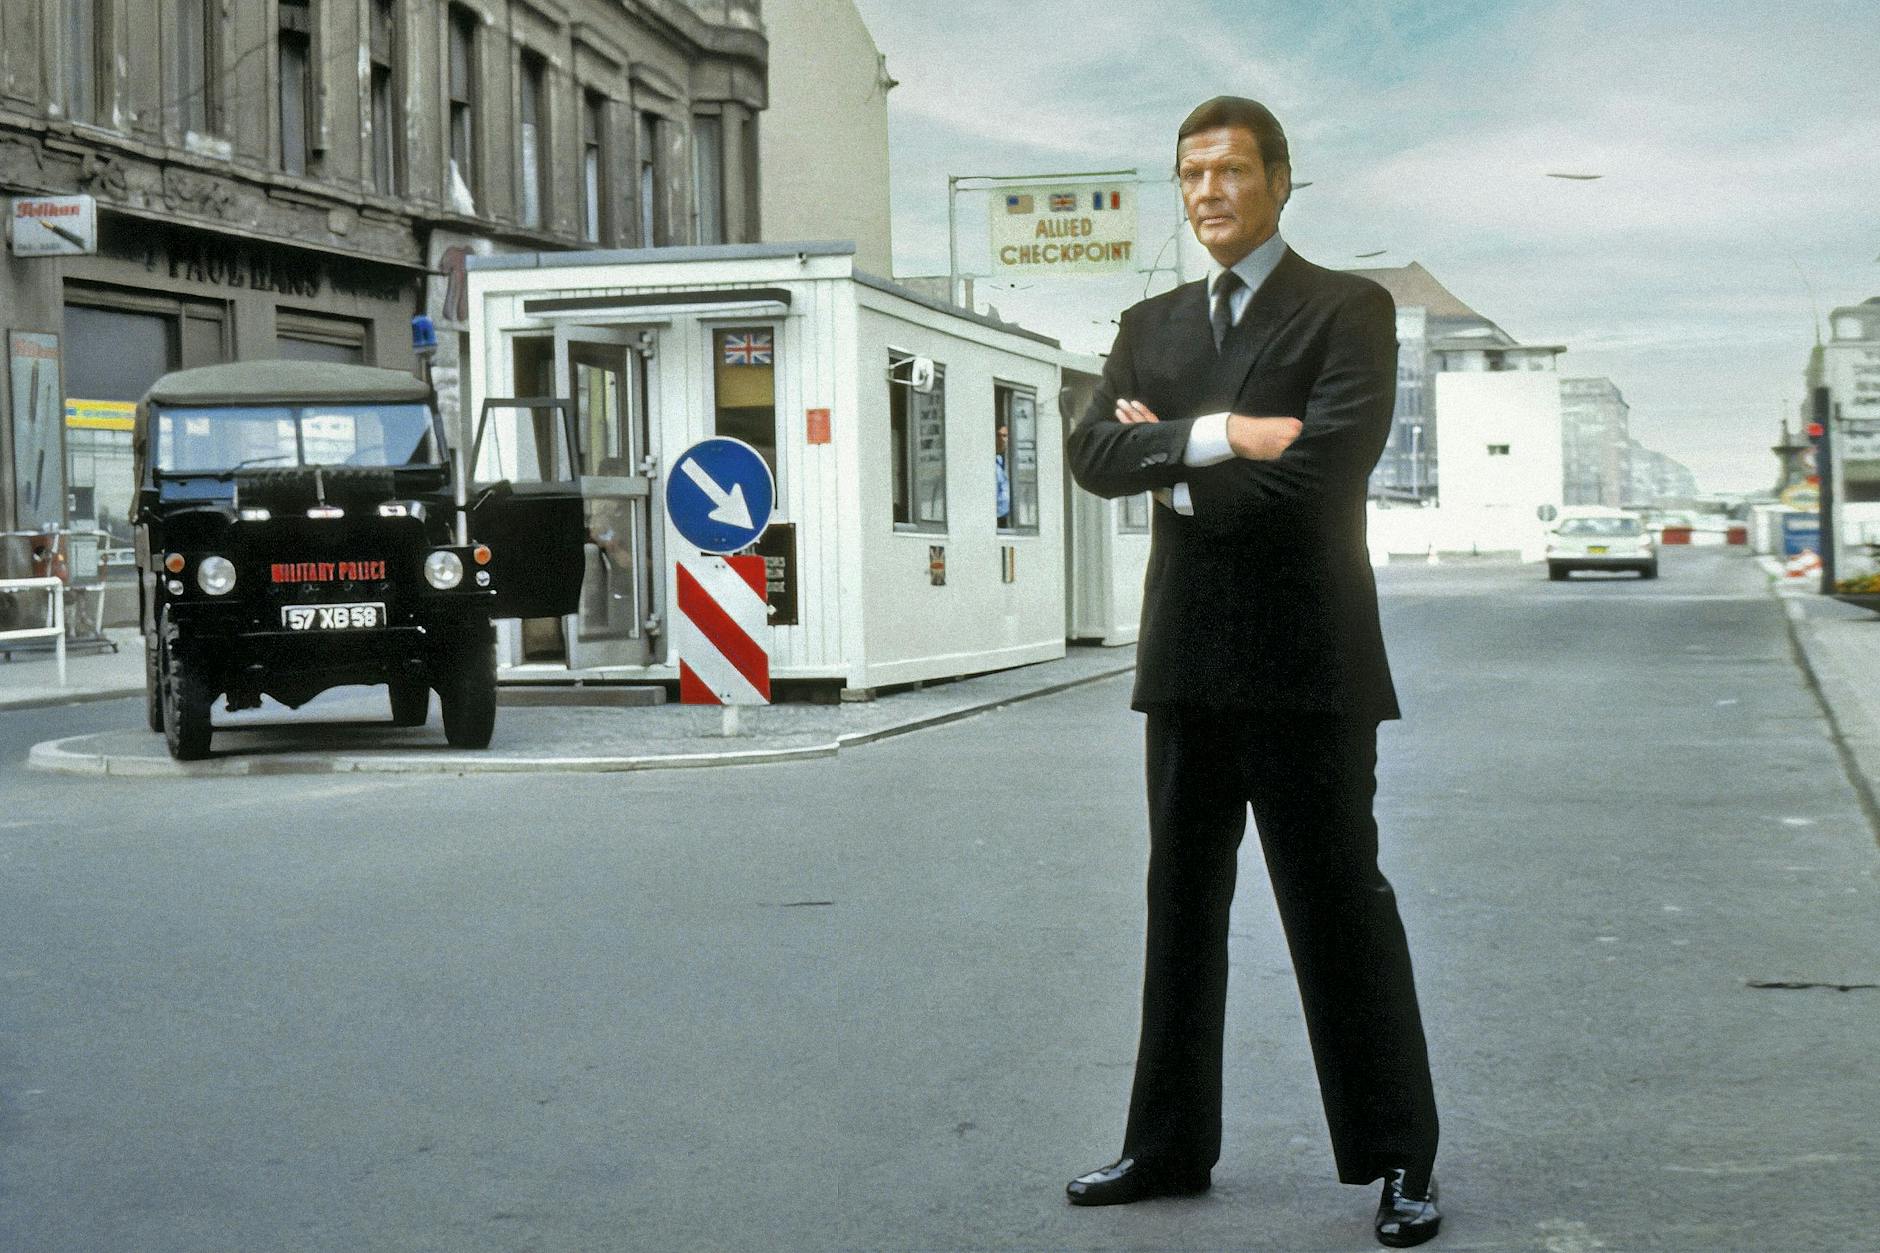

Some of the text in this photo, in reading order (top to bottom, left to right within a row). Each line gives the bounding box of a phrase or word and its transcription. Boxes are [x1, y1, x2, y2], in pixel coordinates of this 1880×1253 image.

[1035, 217, 1093, 239] ALLIED
[1000, 240, 1133, 266] CHECKPOINT
[271, 562, 335, 583] MILITARY
[288, 609, 316, 630] 57
